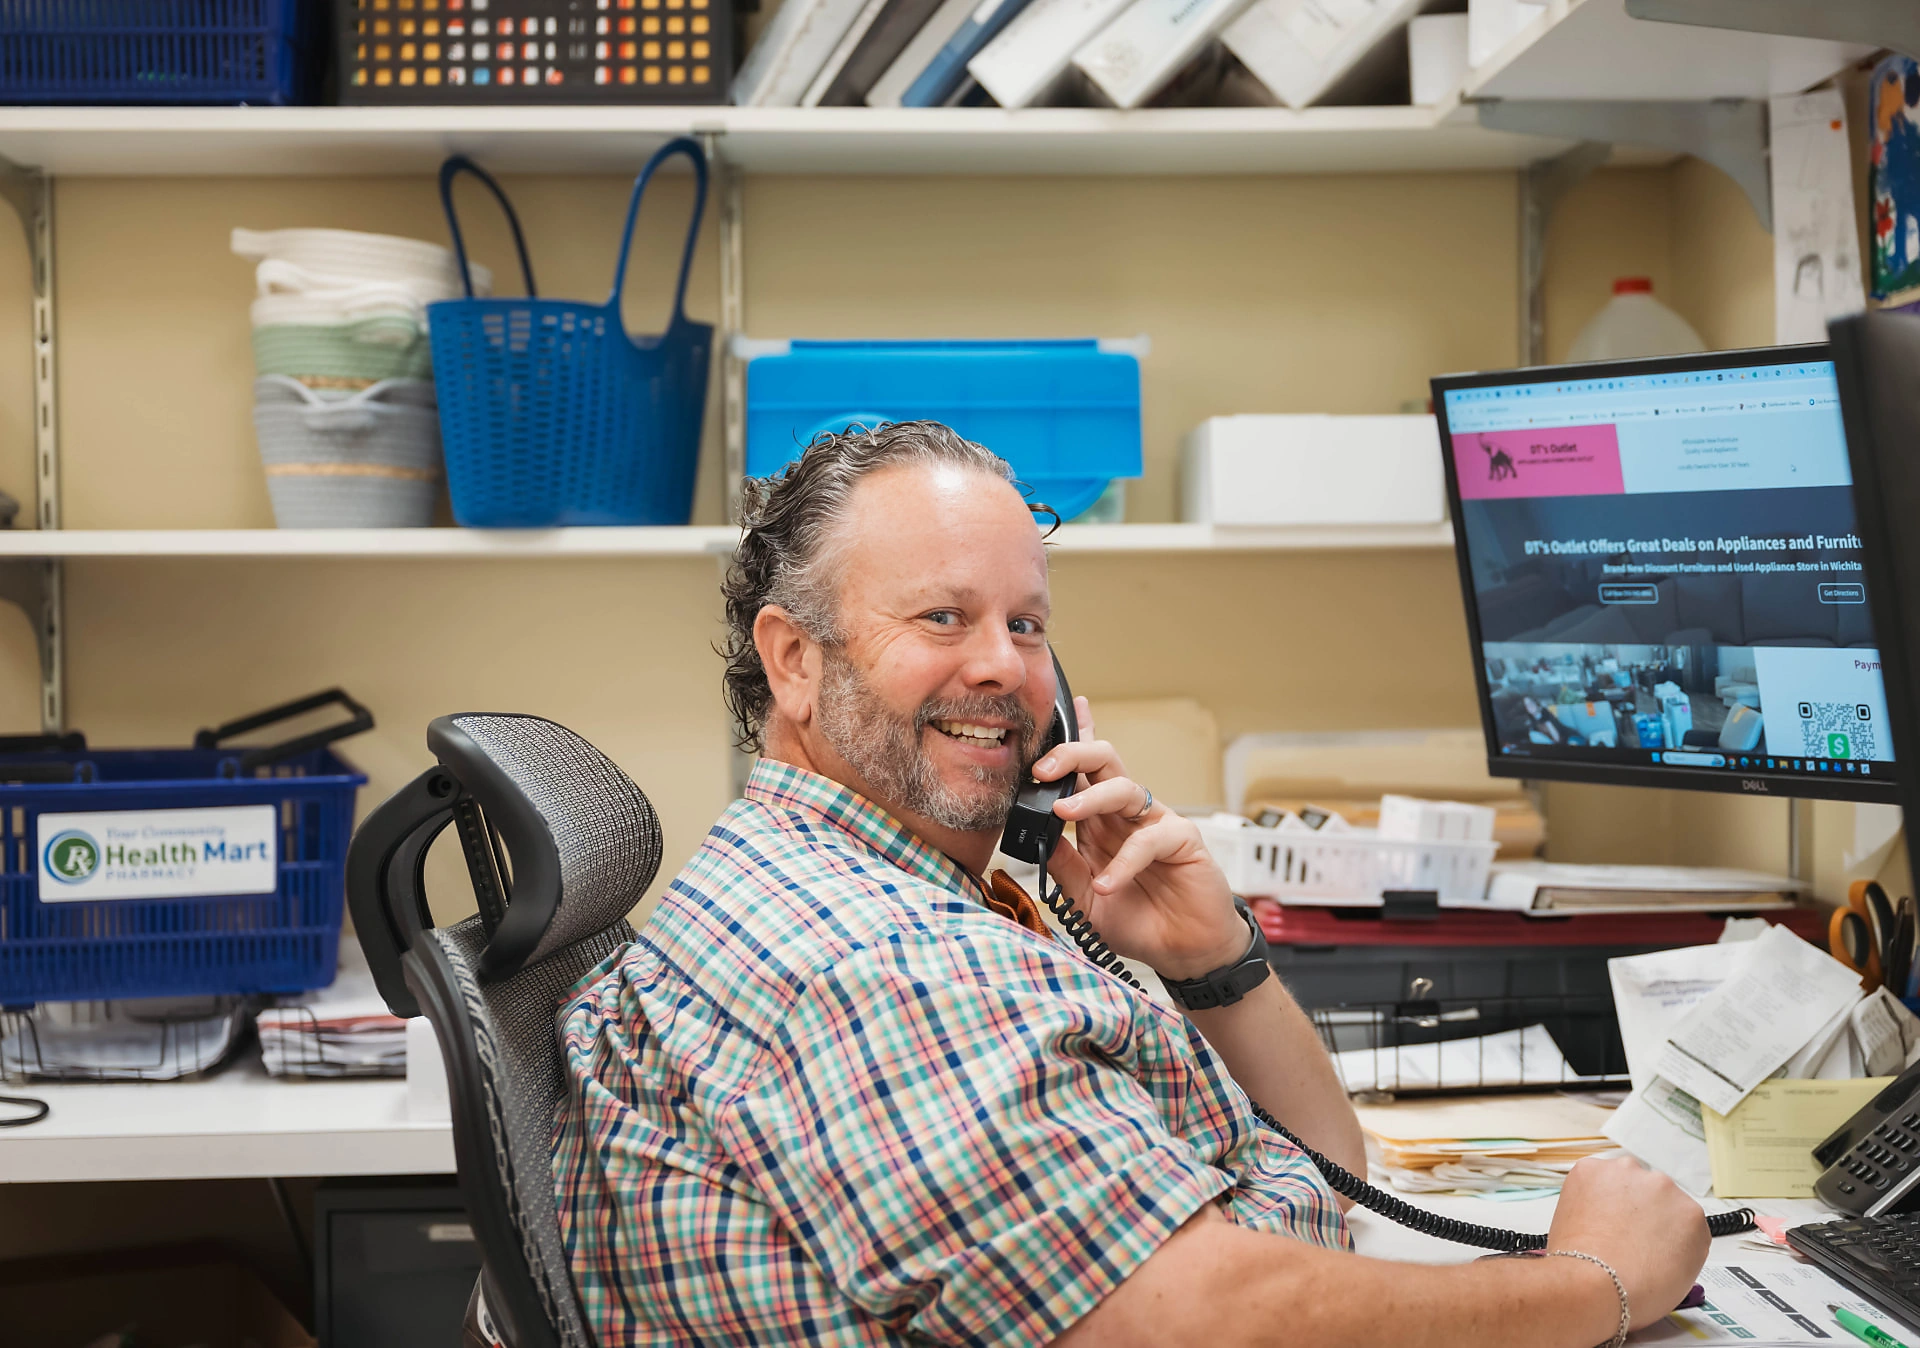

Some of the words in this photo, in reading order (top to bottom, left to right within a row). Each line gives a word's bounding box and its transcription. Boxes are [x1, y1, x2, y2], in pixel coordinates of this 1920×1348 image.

[1530, 444, 1549, 454] DT's
[1550, 443, 1578, 453] Outlet
[1524, 540, 1550, 554] DT's
[1550, 539, 1588, 554] Outlet
[1589, 538, 1626, 553] Offers
[1627, 538, 1660, 553] Great
[1662, 537, 1696, 552] Deals
[1698, 540, 1714, 551] on
[1716, 535, 1786, 554] Appliances
[1789, 535, 1814, 550] and
[1603, 564, 1626, 573] Brand
[1627, 564, 1643, 573] New
[1645, 563, 1678, 573] Discount
[1679, 563, 1716, 573] Furniture
[1717, 562, 1732, 572] and
[1733, 562, 1754, 572] Used
[1755, 561, 1796, 574] Appliance
[1797, 561, 1819, 572] Store
[1820, 561, 1829, 571] in
[1830, 561, 1862, 571] Wichita
[1823, 589, 1833, 597] Get
[1834, 589, 1859, 597] Directions
[1742, 779, 1768, 791] DELL
[106, 827, 138, 840] Your
[141, 825, 225, 839] Community
[105, 842, 198, 867] Health
[203, 840, 269, 863] Mart
[105, 868, 195, 881] PHARMACY
